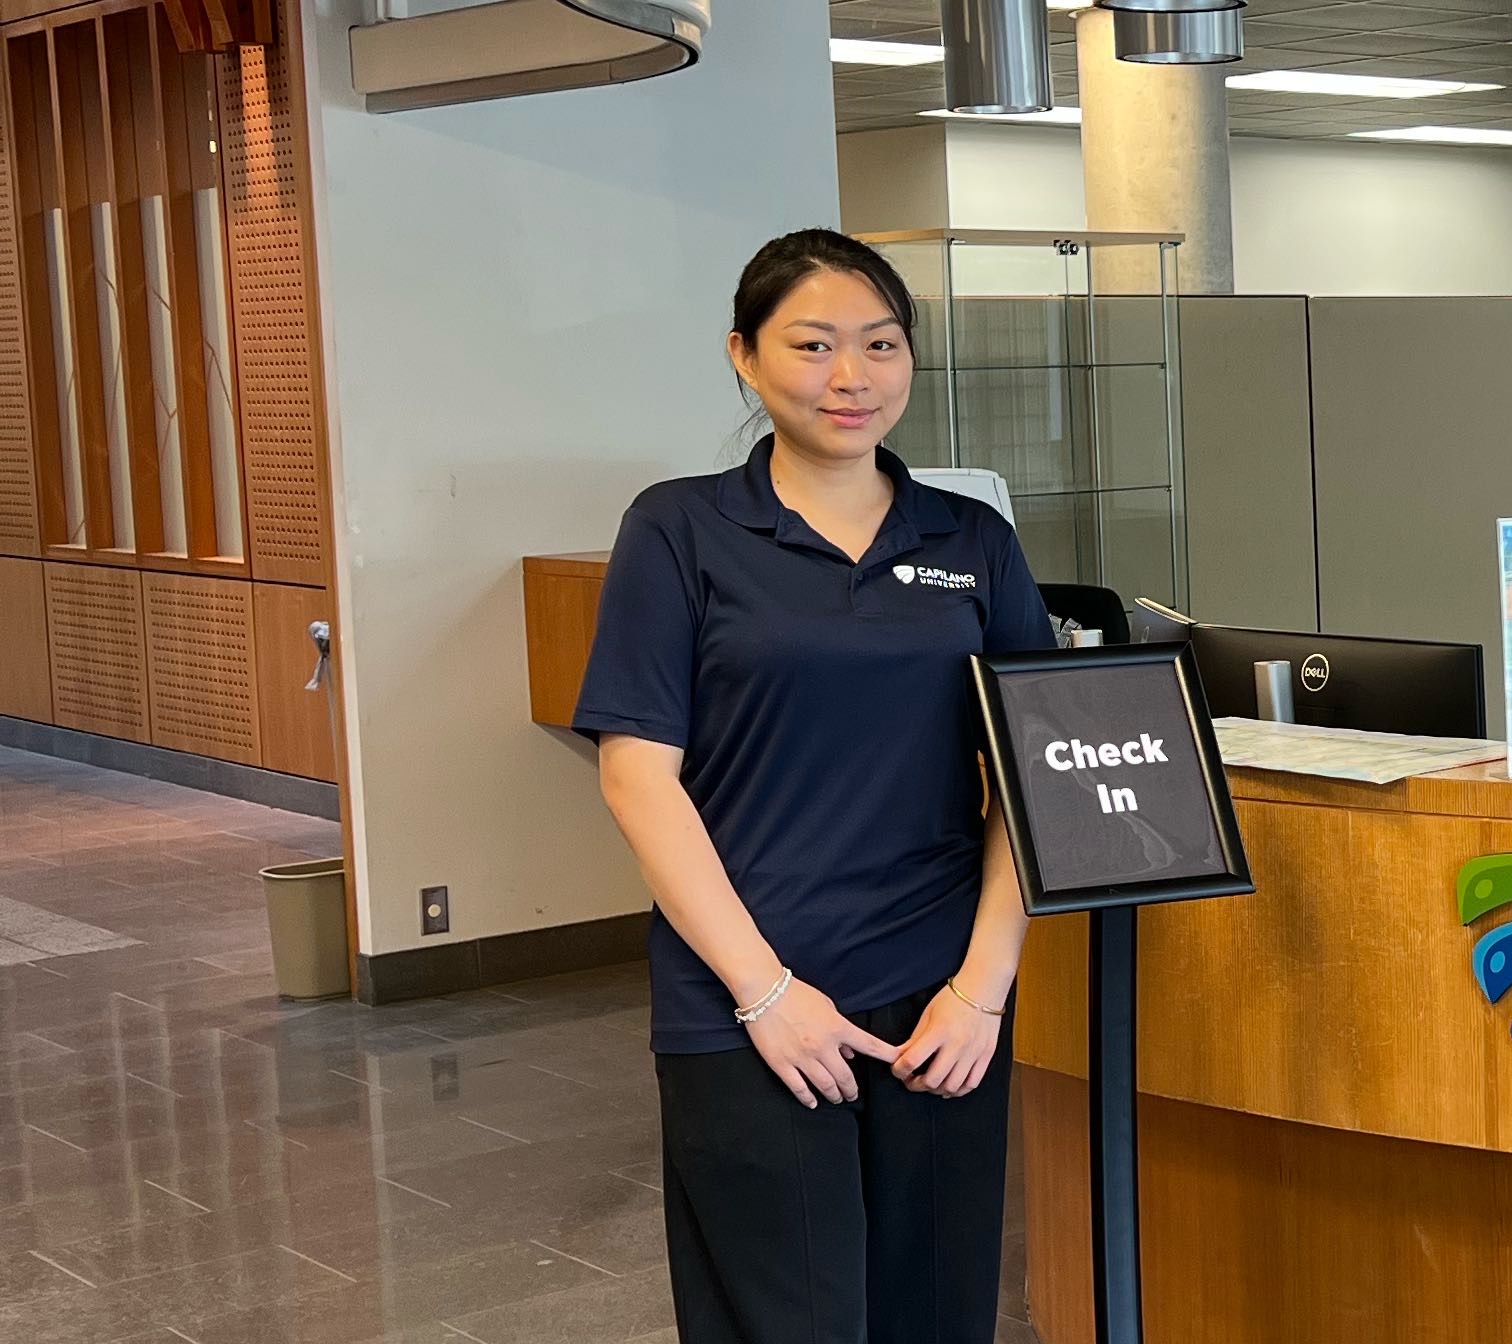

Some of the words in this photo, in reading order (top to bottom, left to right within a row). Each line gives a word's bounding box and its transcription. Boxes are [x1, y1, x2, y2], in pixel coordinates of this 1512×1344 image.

[917, 566, 976, 584] CAPILANO
[919, 577, 976, 589] UNIVERSITY
[1304, 667, 1326, 679] DELL
[1045, 733, 1169, 771] Check
[1096, 784, 1138, 814] In
